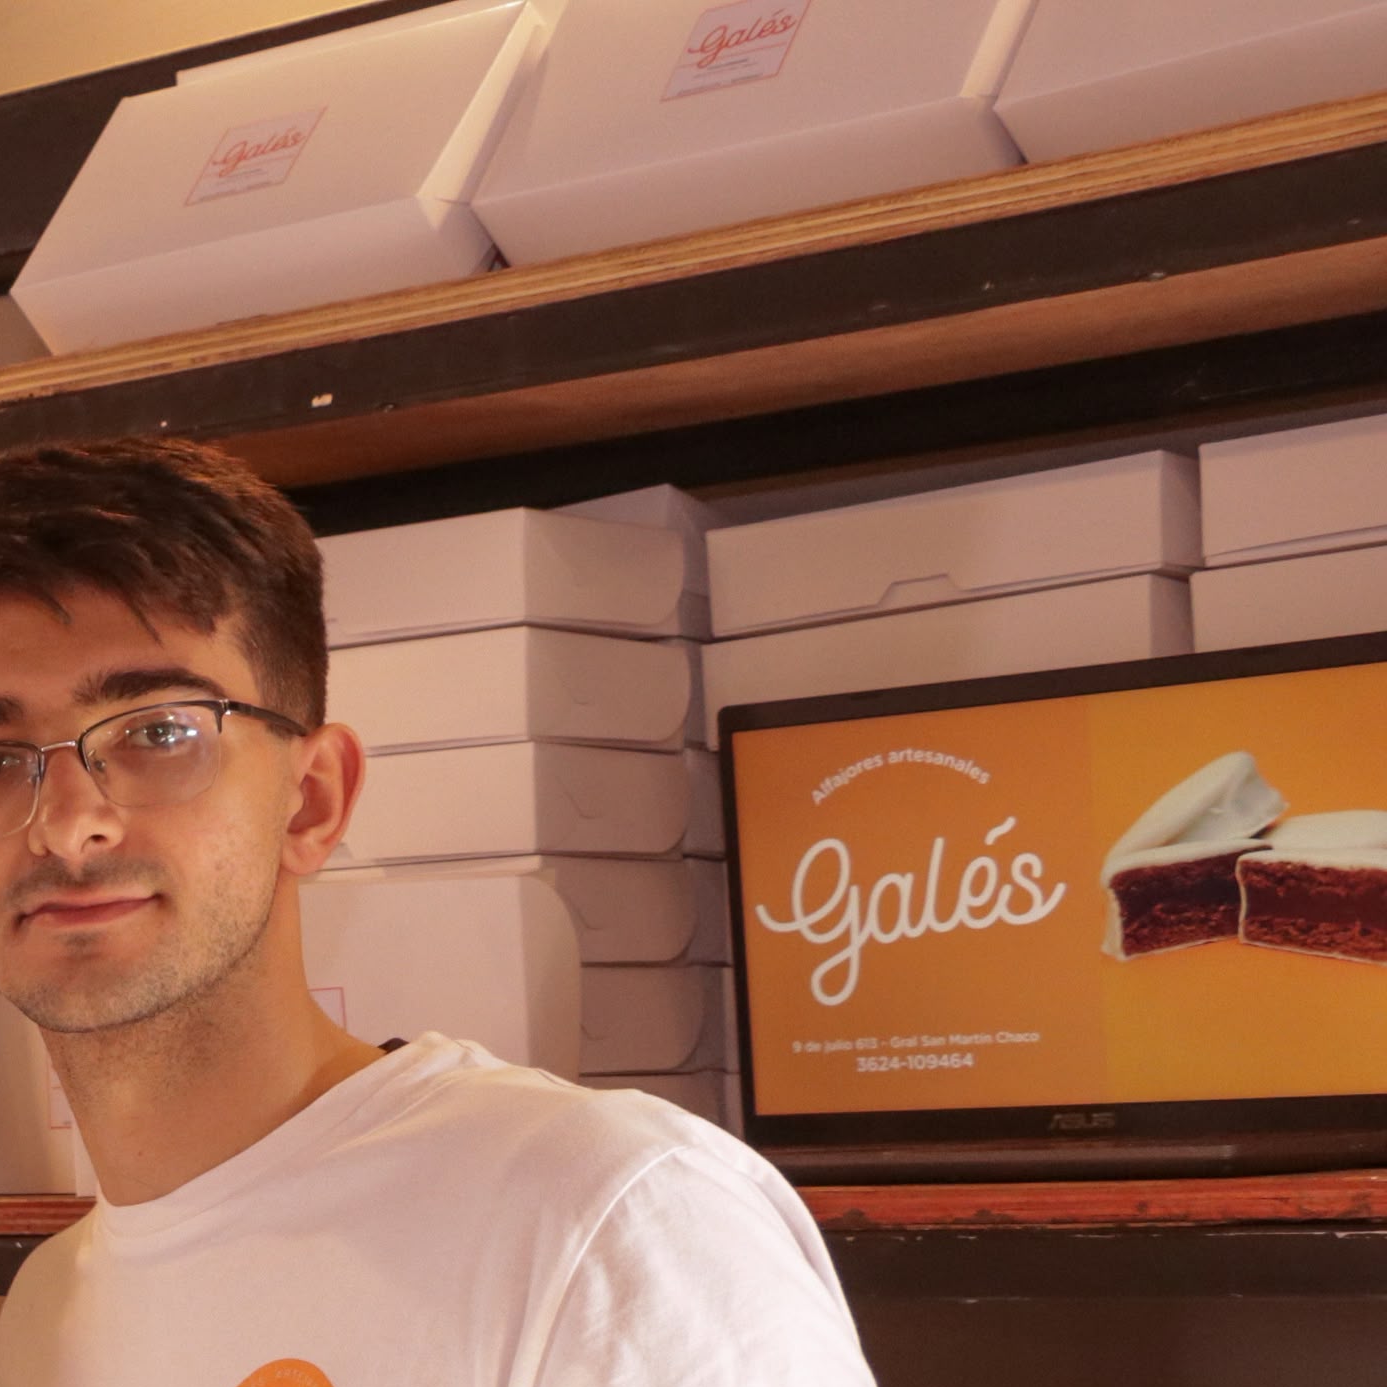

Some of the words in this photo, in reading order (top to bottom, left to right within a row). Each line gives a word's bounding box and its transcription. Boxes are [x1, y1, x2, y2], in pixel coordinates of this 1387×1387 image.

[811, 752, 884, 805] Alfajores
[888, 747, 991, 785] artesanales
[805, 1040, 822, 1053] de
[922, 1034, 946, 1047] San
[996, 1030, 1040, 1044] Chaco
